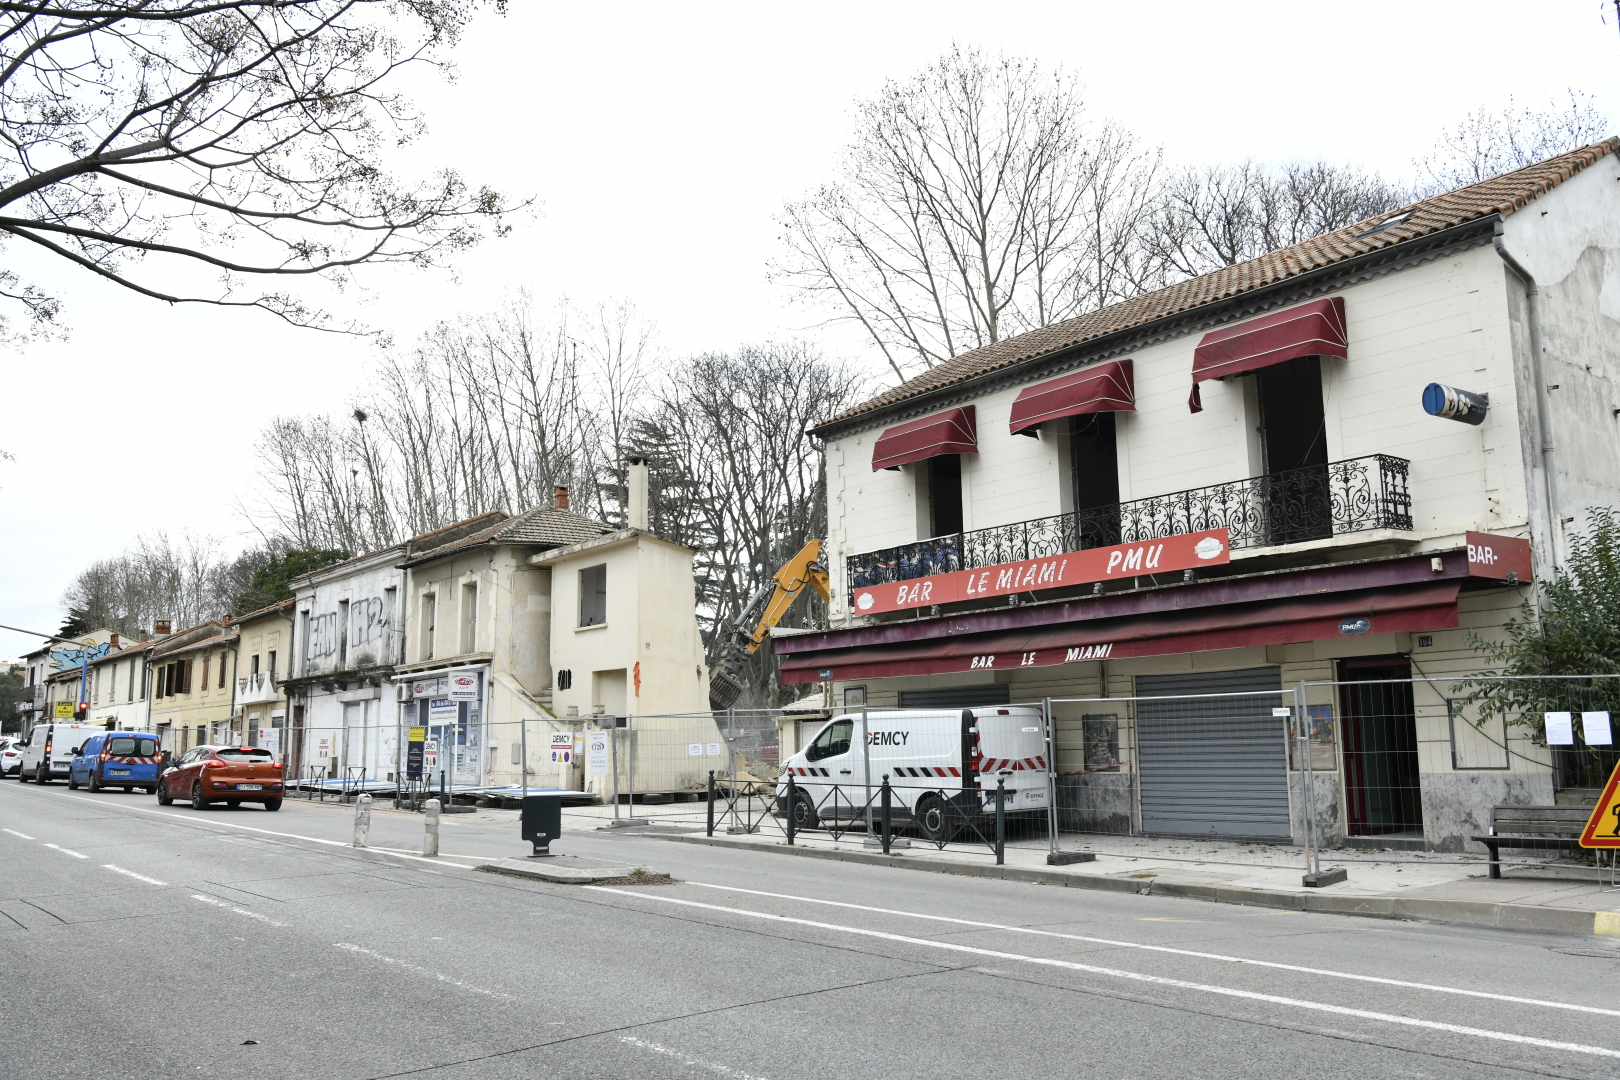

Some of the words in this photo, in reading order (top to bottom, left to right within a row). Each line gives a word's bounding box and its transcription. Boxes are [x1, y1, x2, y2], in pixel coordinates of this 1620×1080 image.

[896, 581, 933, 605] BAR
[966, 571, 990, 594] LE
[996, 559, 1067, 590] MIAMI
[1106, 544, 1163, 574] PMU
[1419, 637, 1432, 647] 104
[970, 655, 995, 669] BAR
[1021, 651, 1036, 666] LE
[1065, 643, 1113, 662] MIAMI
[552, 734, 571, 743] DEMCY
